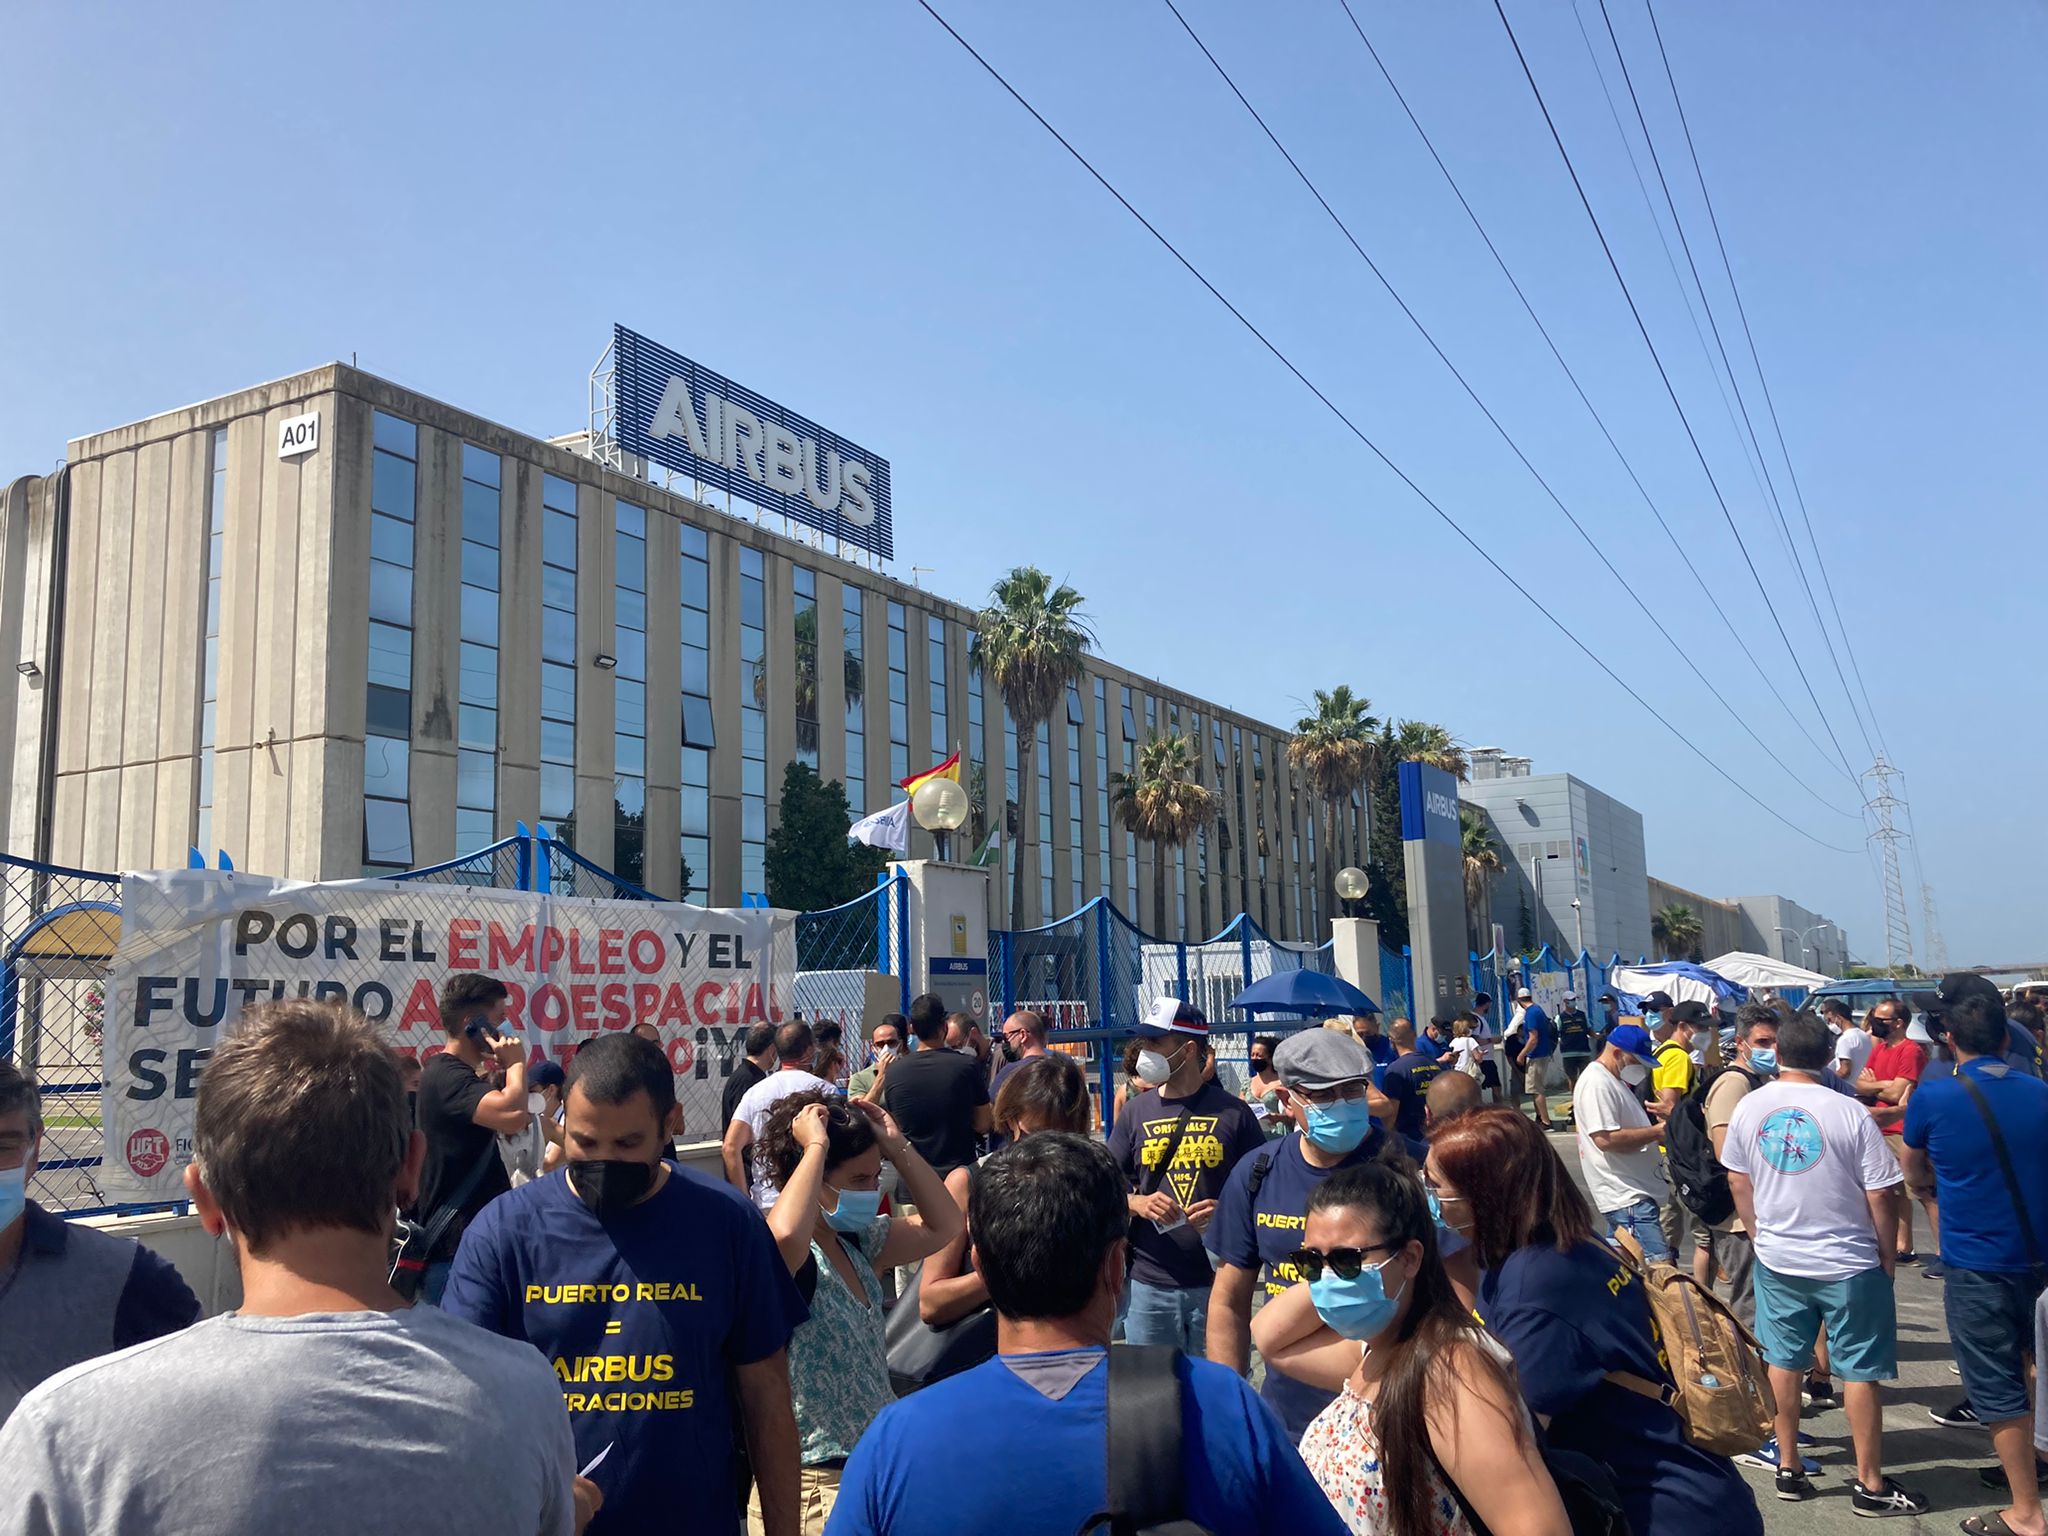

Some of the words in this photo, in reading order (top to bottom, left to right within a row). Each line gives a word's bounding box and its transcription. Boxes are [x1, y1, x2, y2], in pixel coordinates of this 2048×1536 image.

[282, 420, 315, 449] A01
[649, 375, 876, 527] AIRBUS
[1427, 790, 1457, 821] AIRBUS
[235, 910, 359, 960] POR
[379, 918, 437, 963] EL
[448, 918, 667, 975] EMPLEO
[675, 932, 698, 969] Y
[709, 934, 752, 969] EL
[399, 978, 784, 1032] AROESPACIAL
[973, 996, 982, 1009] 20
[1256, 1212, 1307, 1230] PUERT
[525, 1284, 630, 1304] PUERTO
[636, 1282, 703, 1302] REAL
[552, 1354, 674, 1383] AIRBUS
[563, 1389, 695, 1412] RACIONES
